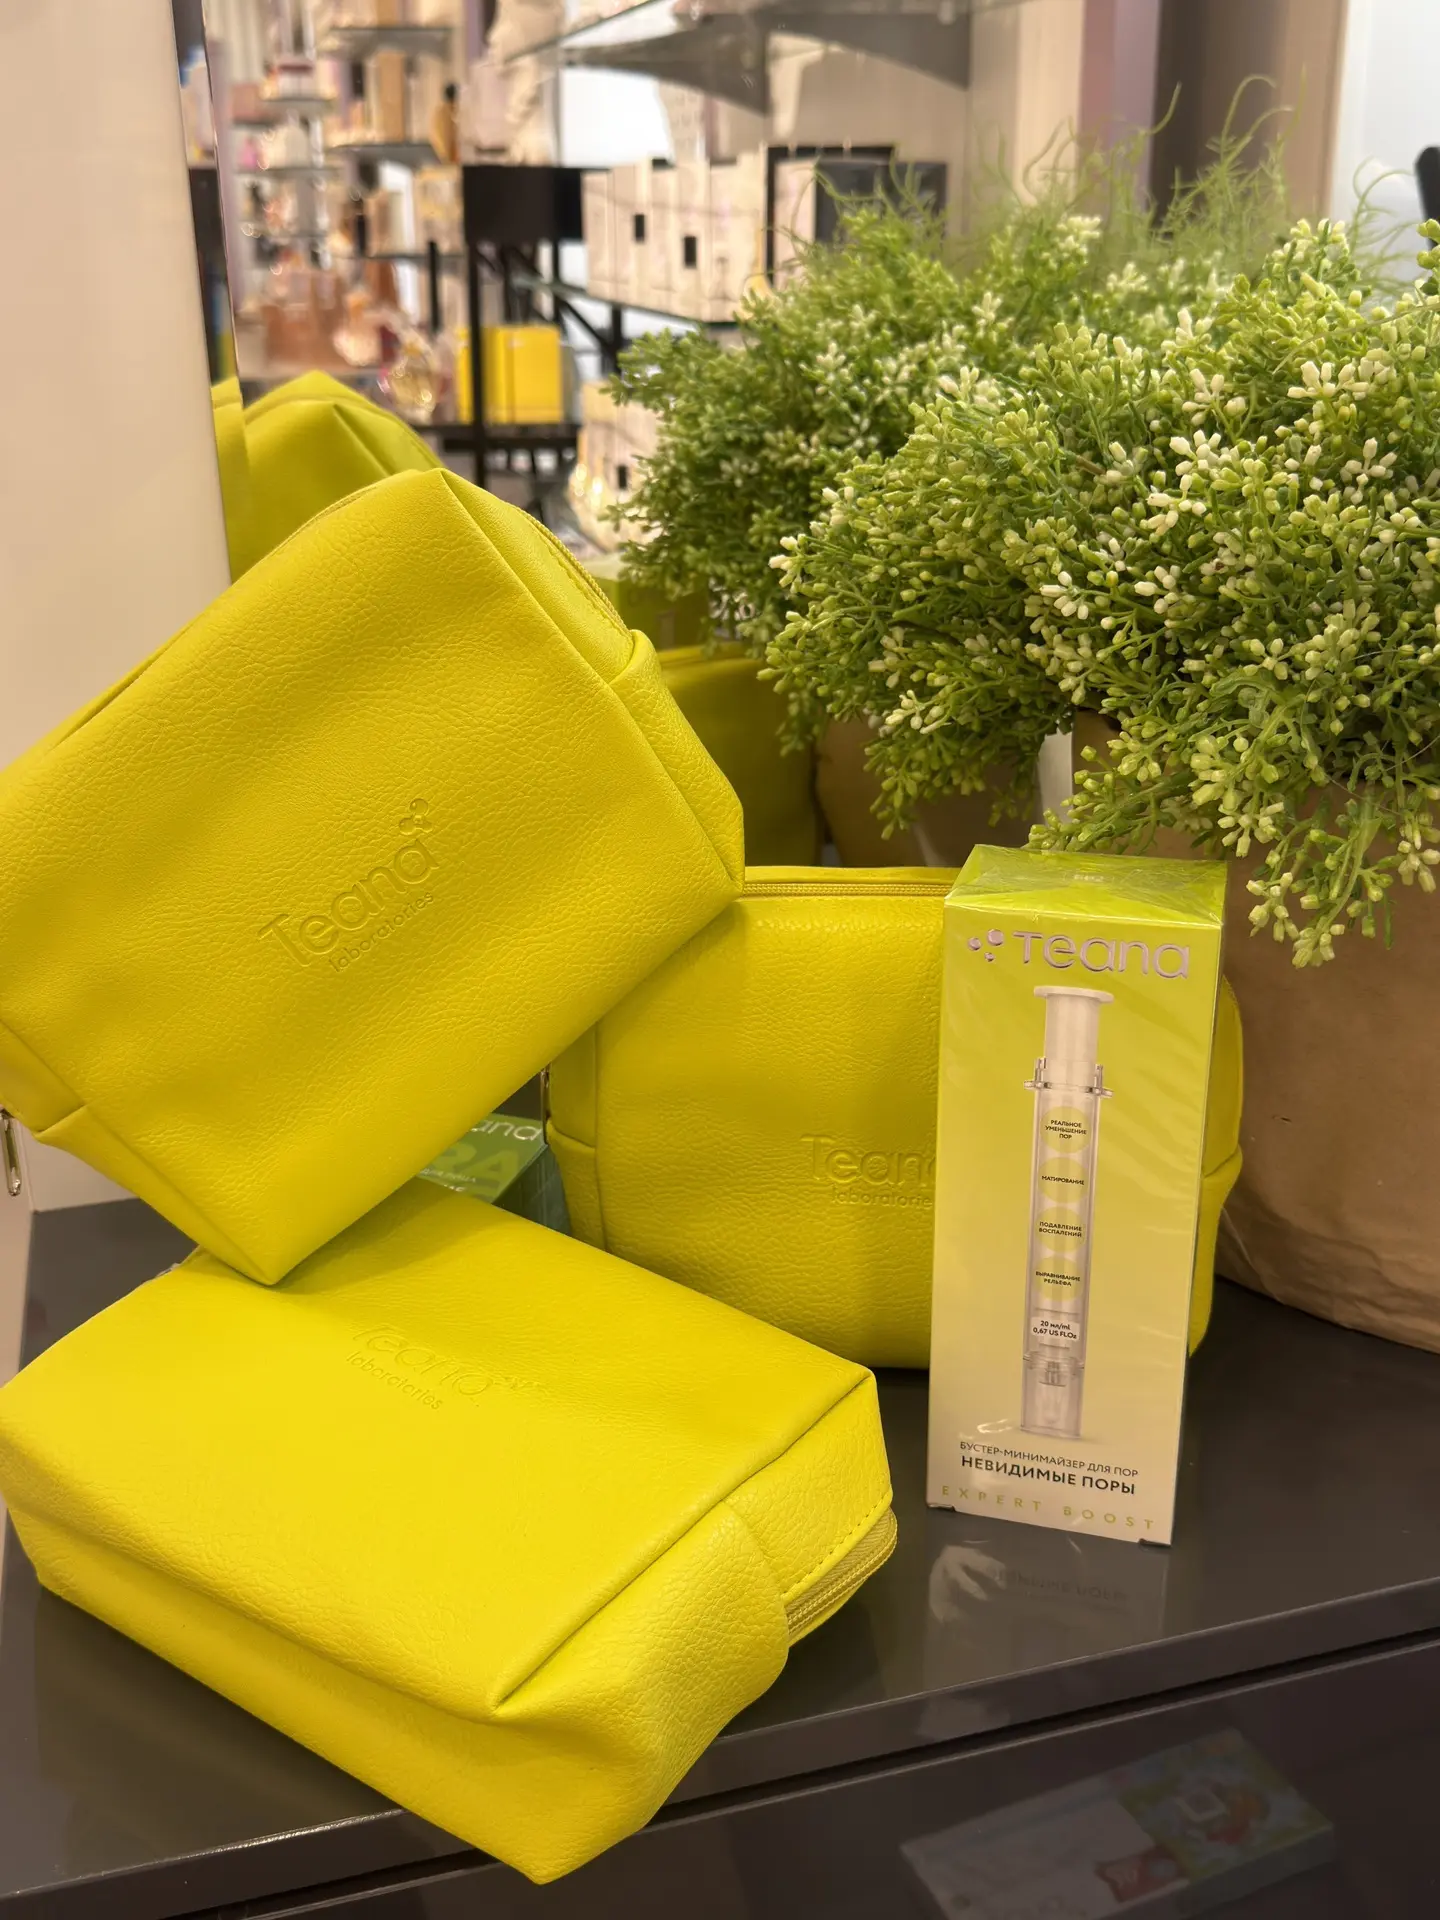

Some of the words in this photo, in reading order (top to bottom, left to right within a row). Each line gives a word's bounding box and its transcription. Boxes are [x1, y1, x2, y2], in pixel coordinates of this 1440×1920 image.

[257, 838, 440, 967] Teana
[328, 892, 434, 972] laboratories
[1012, 930, 1191, 979] Teana
[1045, 1125, 1087, 1135] УМЕНЬШЕНИЕ
[1050, 1120, 1082, 1128] РЕАЛЬНОЕ
[800, 1134, 936, 1186] Tean
[1042, 1175, 1085, 1185] МАТИРОВАНИЕ
[832, 1183, 934, 1209] laboratorie
[1039, 1227, 1082, 1237] ВОСПАЛЕНИЙ
[1040, 1221, 1082, 1231] ПОДАВЛЕНИЕ
[1035, 1271, 1081, 1281] ВЫРАВНИВАНИЕ
[1044, 1278, 1072, 1286] РЕЛЬЕФА
[346, 1351, 443, 1410] laboratories
[960, 1441, 1085, 1469] БУСТЕР-МИНИМАЙЗЕР
[1087, 1462, 1110, 1473] ДЛЯ
[1113, 1466, 1138, 1478] ПОР
[961, 1455, 1076, 1485] НЕВИДИМЫЕ
[1082, 1476, 1135, 1495] ПОРЫ
[941, 1485, 1042, 1512] EXPERT
[1063, 1506, 1154, 1530] BOOST
